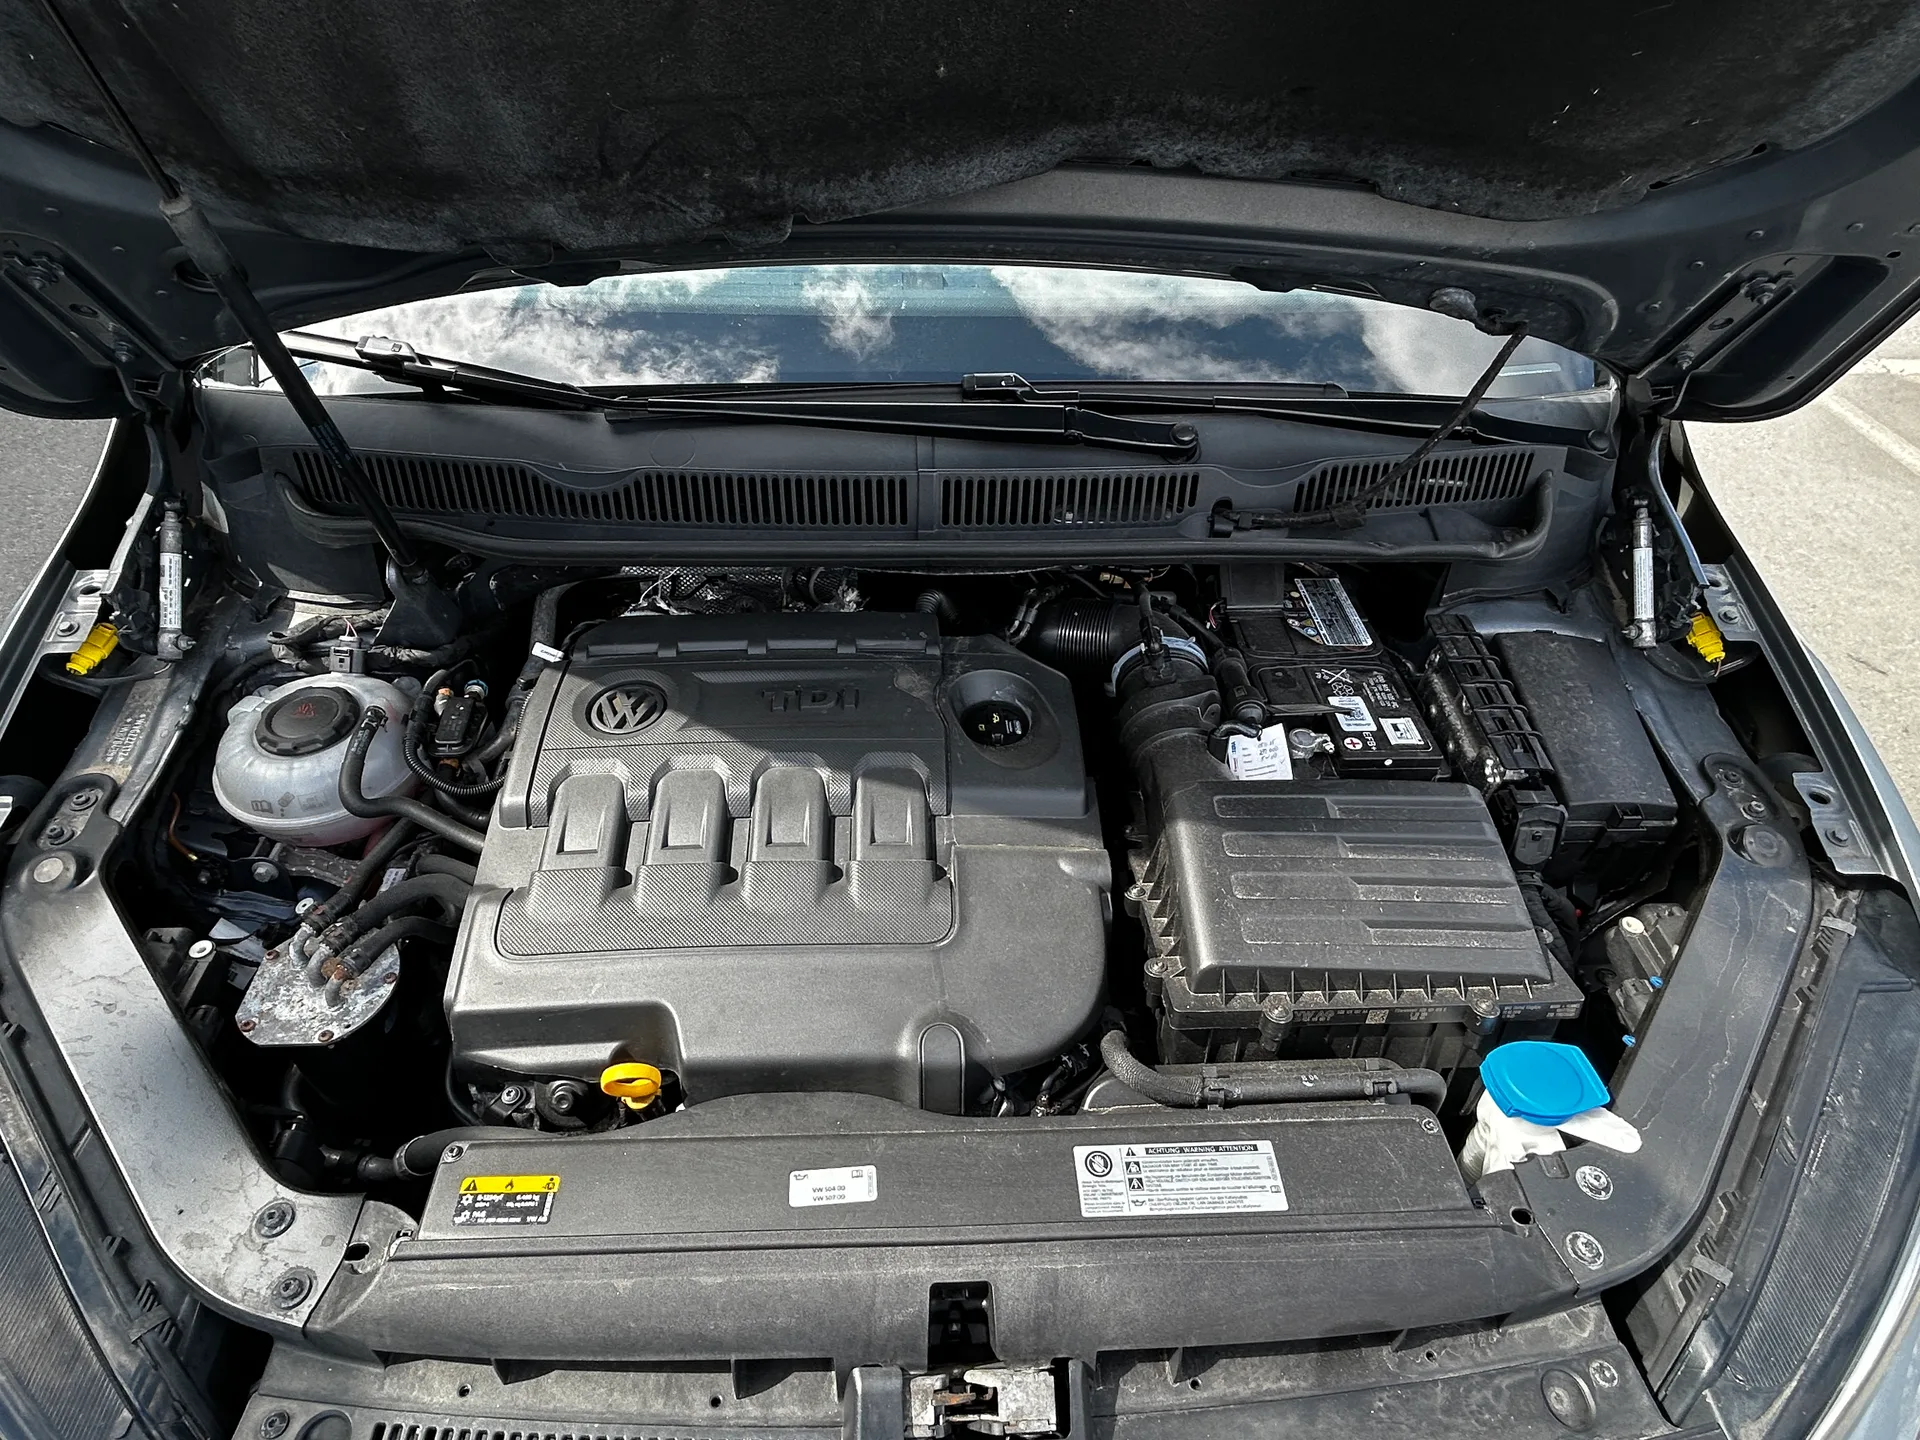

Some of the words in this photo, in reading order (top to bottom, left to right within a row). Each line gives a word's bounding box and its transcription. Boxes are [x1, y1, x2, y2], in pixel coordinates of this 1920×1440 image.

[762, 686, 859, 712] TDI
[1362, 731, 1378, 751] EFB+
[1182, 1145, 1215, 1153] WARNING
[1218, 1144, 1255, 1152] ATTENTION
